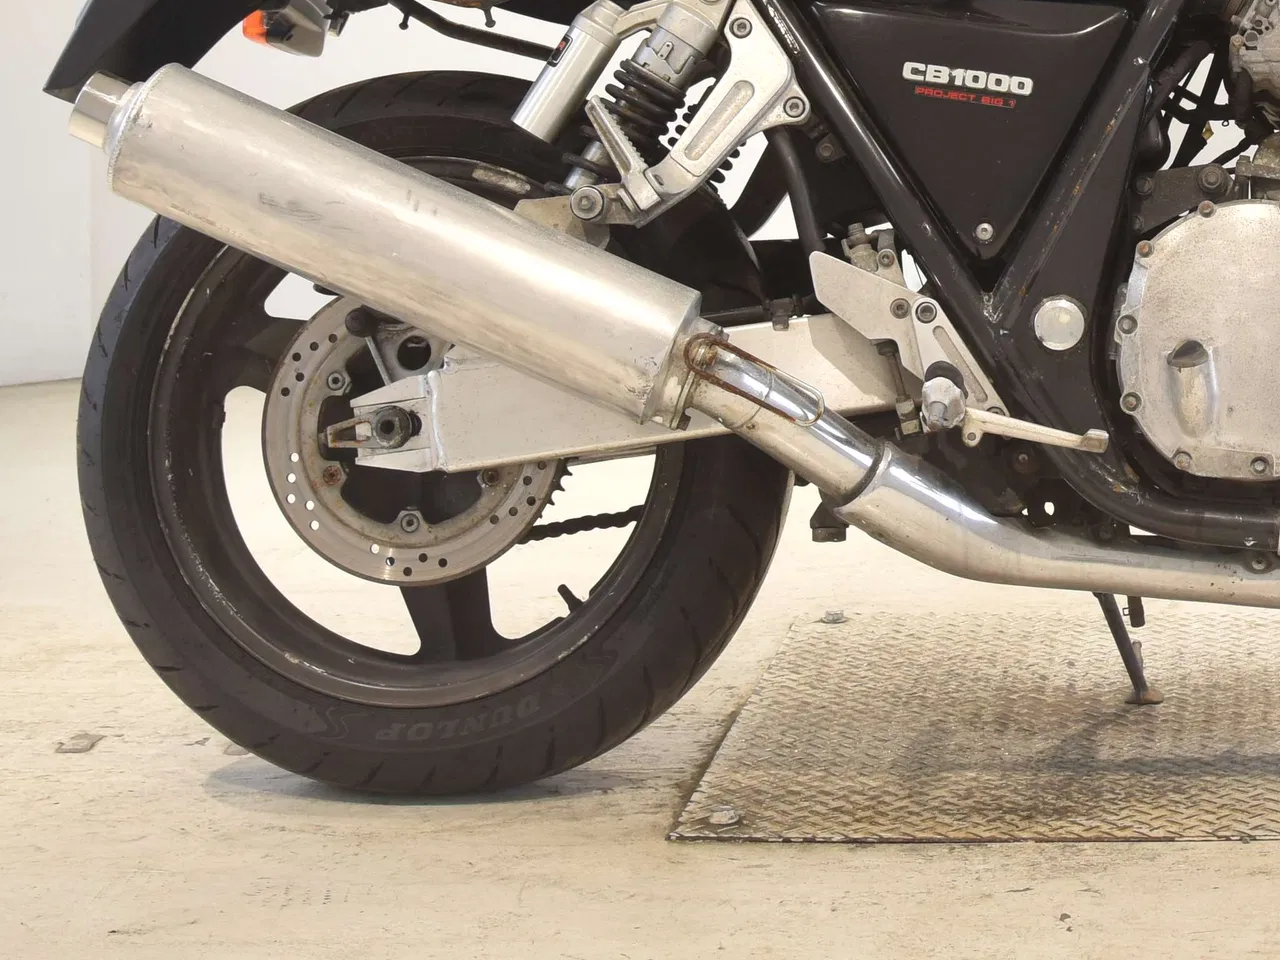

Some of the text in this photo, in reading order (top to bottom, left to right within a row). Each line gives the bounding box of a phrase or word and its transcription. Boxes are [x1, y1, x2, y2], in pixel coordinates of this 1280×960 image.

[902, 61, 1034, 96] CB1000
[914, 85, 976, 102] PROJECT
[981, 96, 1004, 107] BIG
[374, 692, 541, 741] DUNLOP
